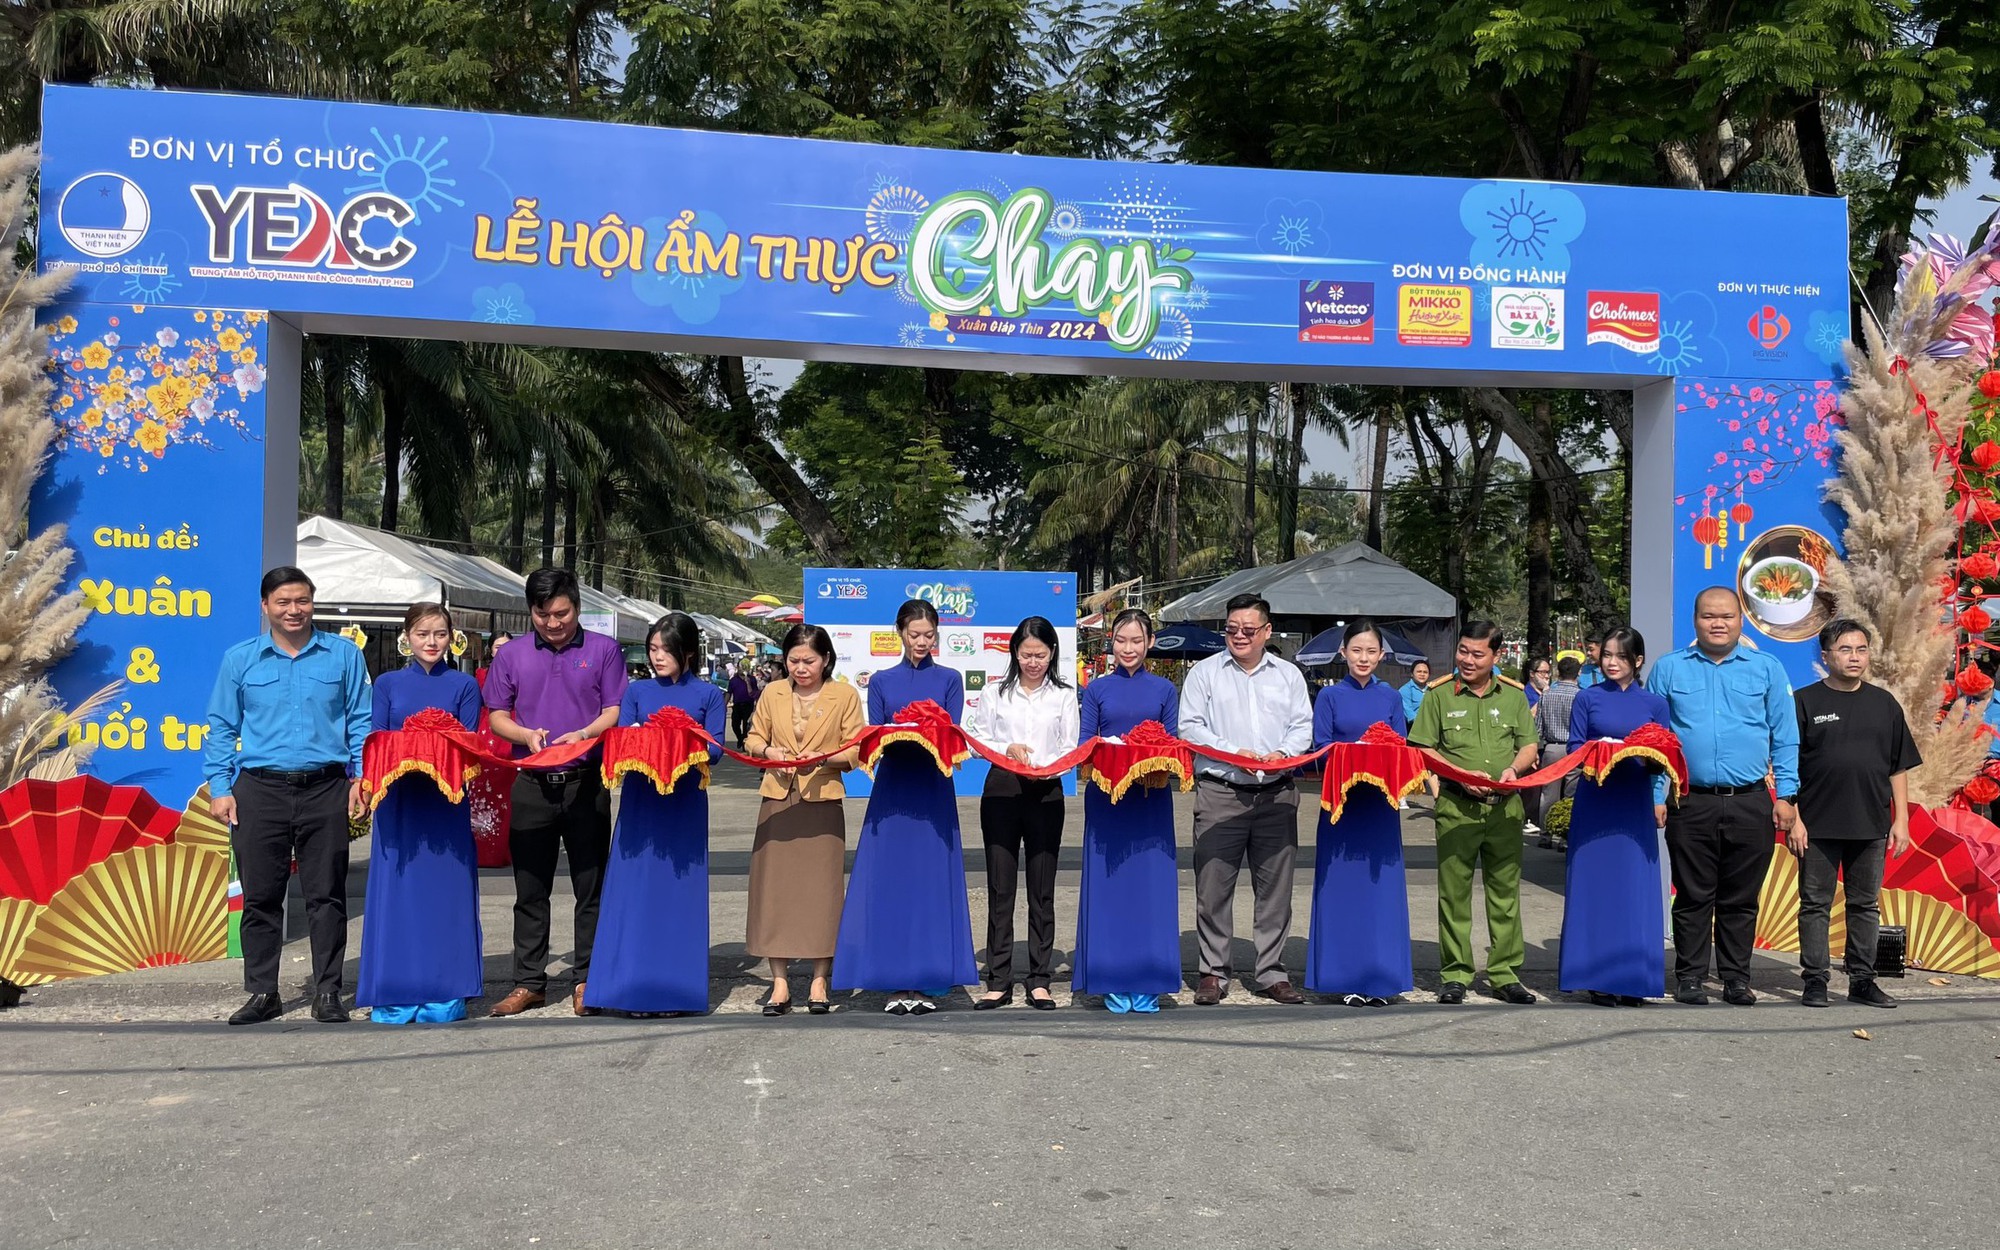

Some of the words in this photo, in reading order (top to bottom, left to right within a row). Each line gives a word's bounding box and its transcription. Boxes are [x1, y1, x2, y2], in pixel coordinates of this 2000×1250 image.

[129, 136, 195, 161] ĐƠN
[206, 141, 234, 168] VỊ
[245, 138, 283, 166] TỔ
[294, 145, 376, 172] CHỨC
[80, 232, 107, 240] THANH
[108, 232, 127, 241] NIÊN
[103, 241, 122, 249] NAM
[474, 198, 541, 264] LỄ
[549, 213, 646, 279] HỘI
[654, 209, 741, 277] ẨM
[750, 234, 897, 293] THỰC
[142, 265, 167, 275] MINH
[191, 268, 221, 276] TRUNG
[223, 267, 241, 277] TÂM
[257, 270, 276, 280] TRỢ
[276, 272, 305, 280] THANH
[307, 273, 327, 282] NIÊN
[329, 273, 354, 284] CÔNG
[355, 275, 379, 285] NHÂN
[909, 190, 1186, 348] Chay
[1392, 262, 1433, 279] ĐƠN
[1436, 266, 1454, 282] VỊ
[1458, 263, 1511, 282] ĐỒNG
[1516, 266, 1566, 284] HÀNH
[1426, 288, 1446, 296] TRỘN
[1718, 281, 1743, 293] ĐƠN
[1746, 283, 1758, 295] VỊ
[1760, 284, 1791, 297] THỰC
[1793, 284, 1820, 298] HIỆN
[1409, 296, 1461, 309] MIKKO
[1589, 301, 1657, 323] Cholimex
[1510, 310, 1523, 319] BÀ
[957, 319, 987, 332] Xuân
[990, 320, 1016, 336] Giáp
[1047, 321, 1096, 340] 2024
[93, 524, 151, 549] Chủ
[156, 522, 200, 550] đề:
[78, 576, 212, 618] Xuân
[915, 582, 974, 615] Chay
[126, 646, 161, 683] &
